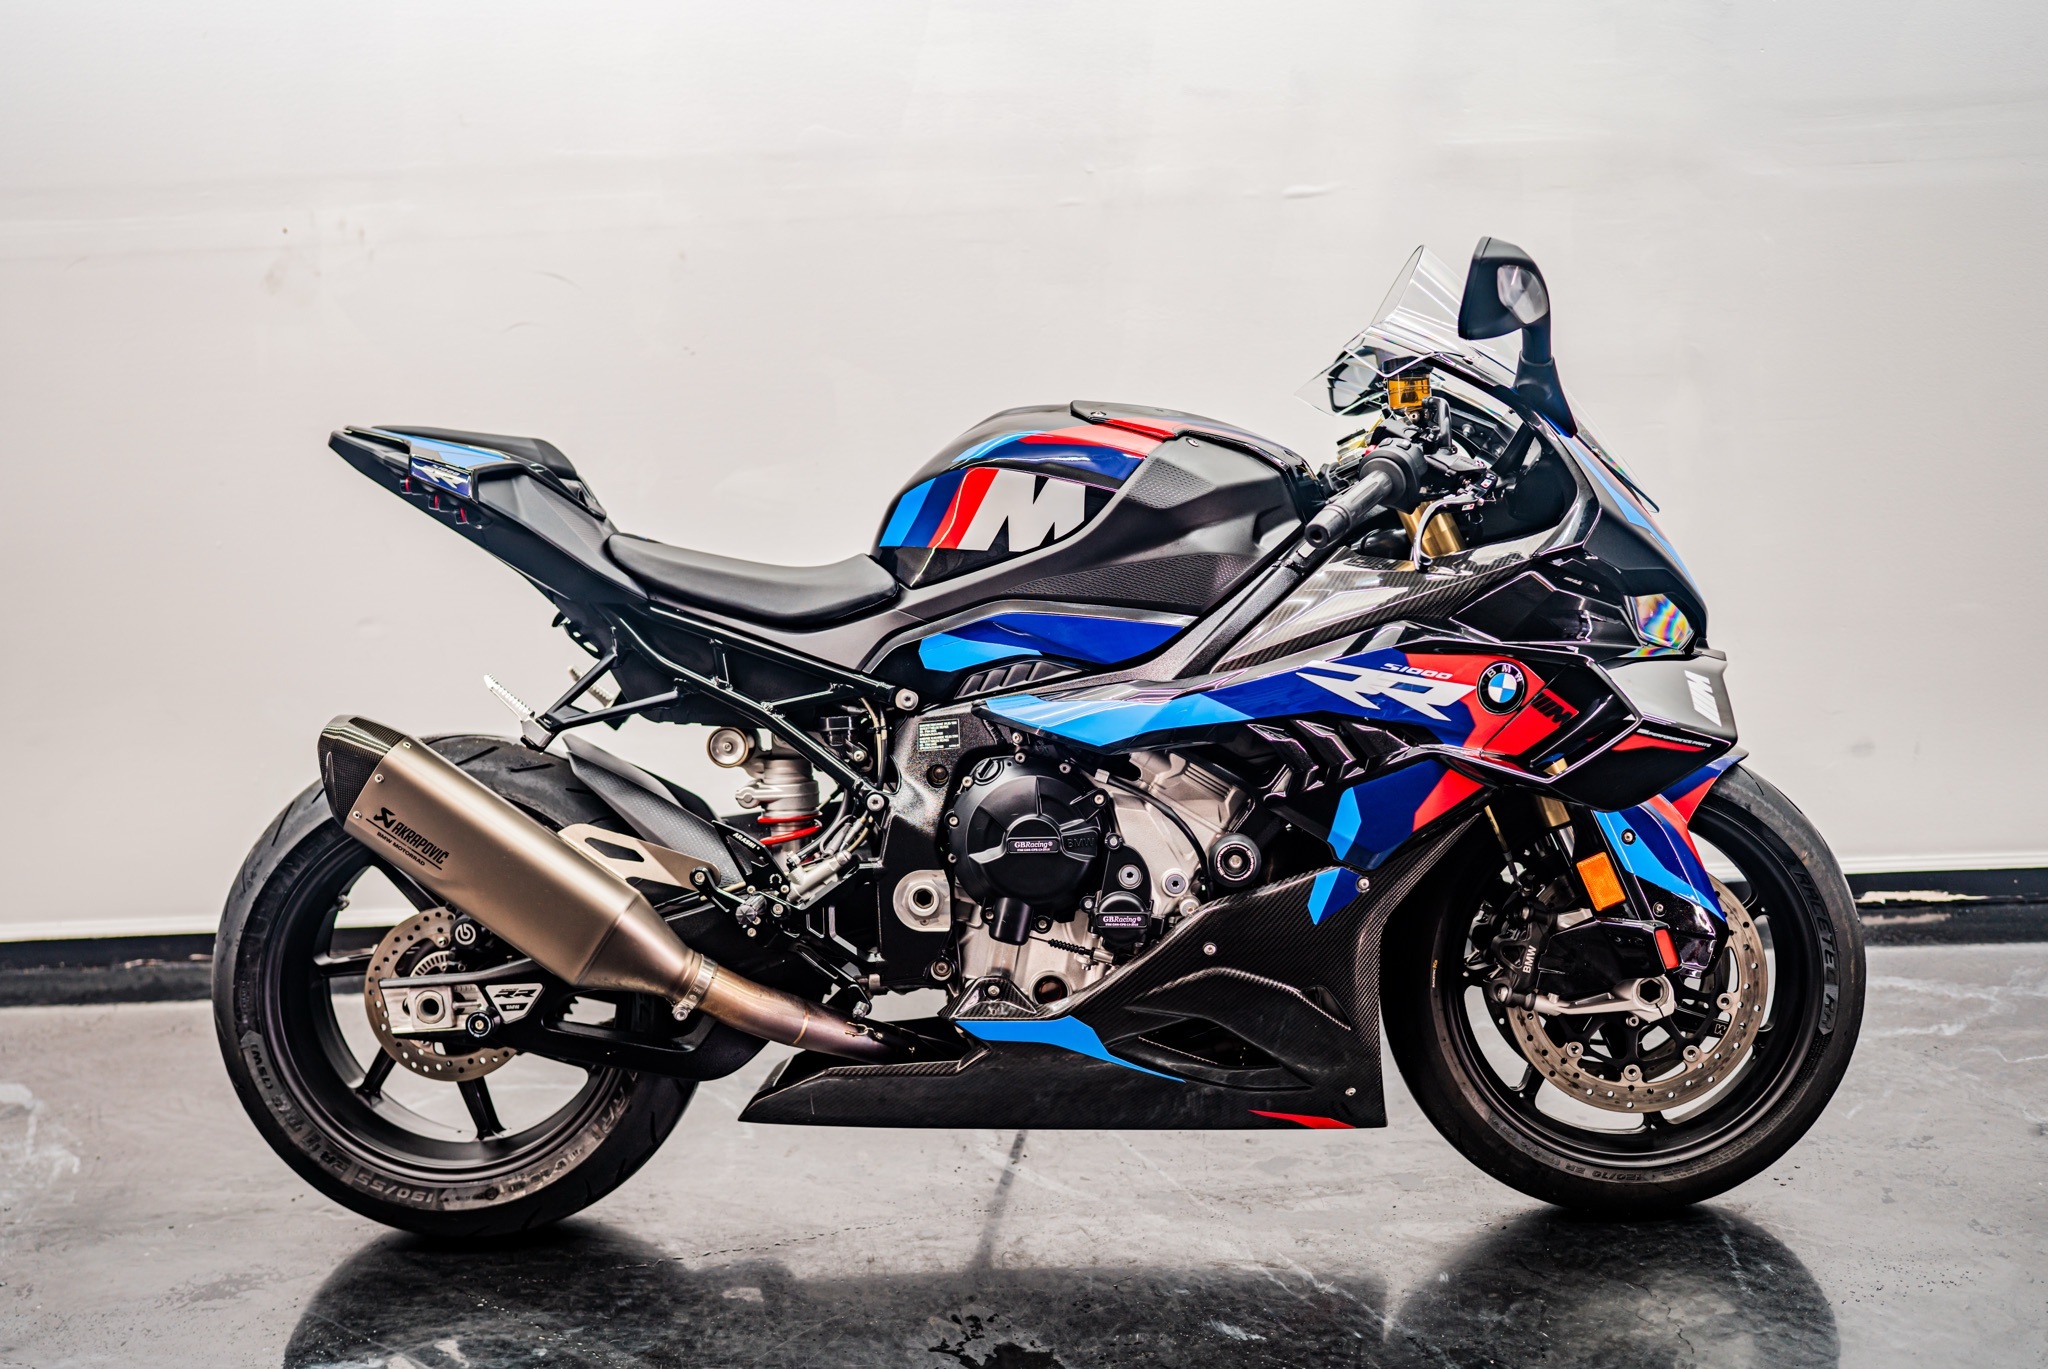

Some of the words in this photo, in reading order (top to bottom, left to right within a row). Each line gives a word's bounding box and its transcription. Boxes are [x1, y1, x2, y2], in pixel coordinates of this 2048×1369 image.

[1380, 662, 1453, 680] S1000
[1486, 664, 1524, 683] BMW
[1296, 660, 1478, 722] RR
[376, 831, 393, 844] BMW
[392, 842, 426, 866] MOTORRAD
[732, 832, 757, 849] ARASHI
[1067, 837, 1095, 848] BMW
[1793, 870, 1838, 986] RACETEC
[1522, 945, 1537, 974] BMW
[354, 1172, 435, 1203] 190/55
